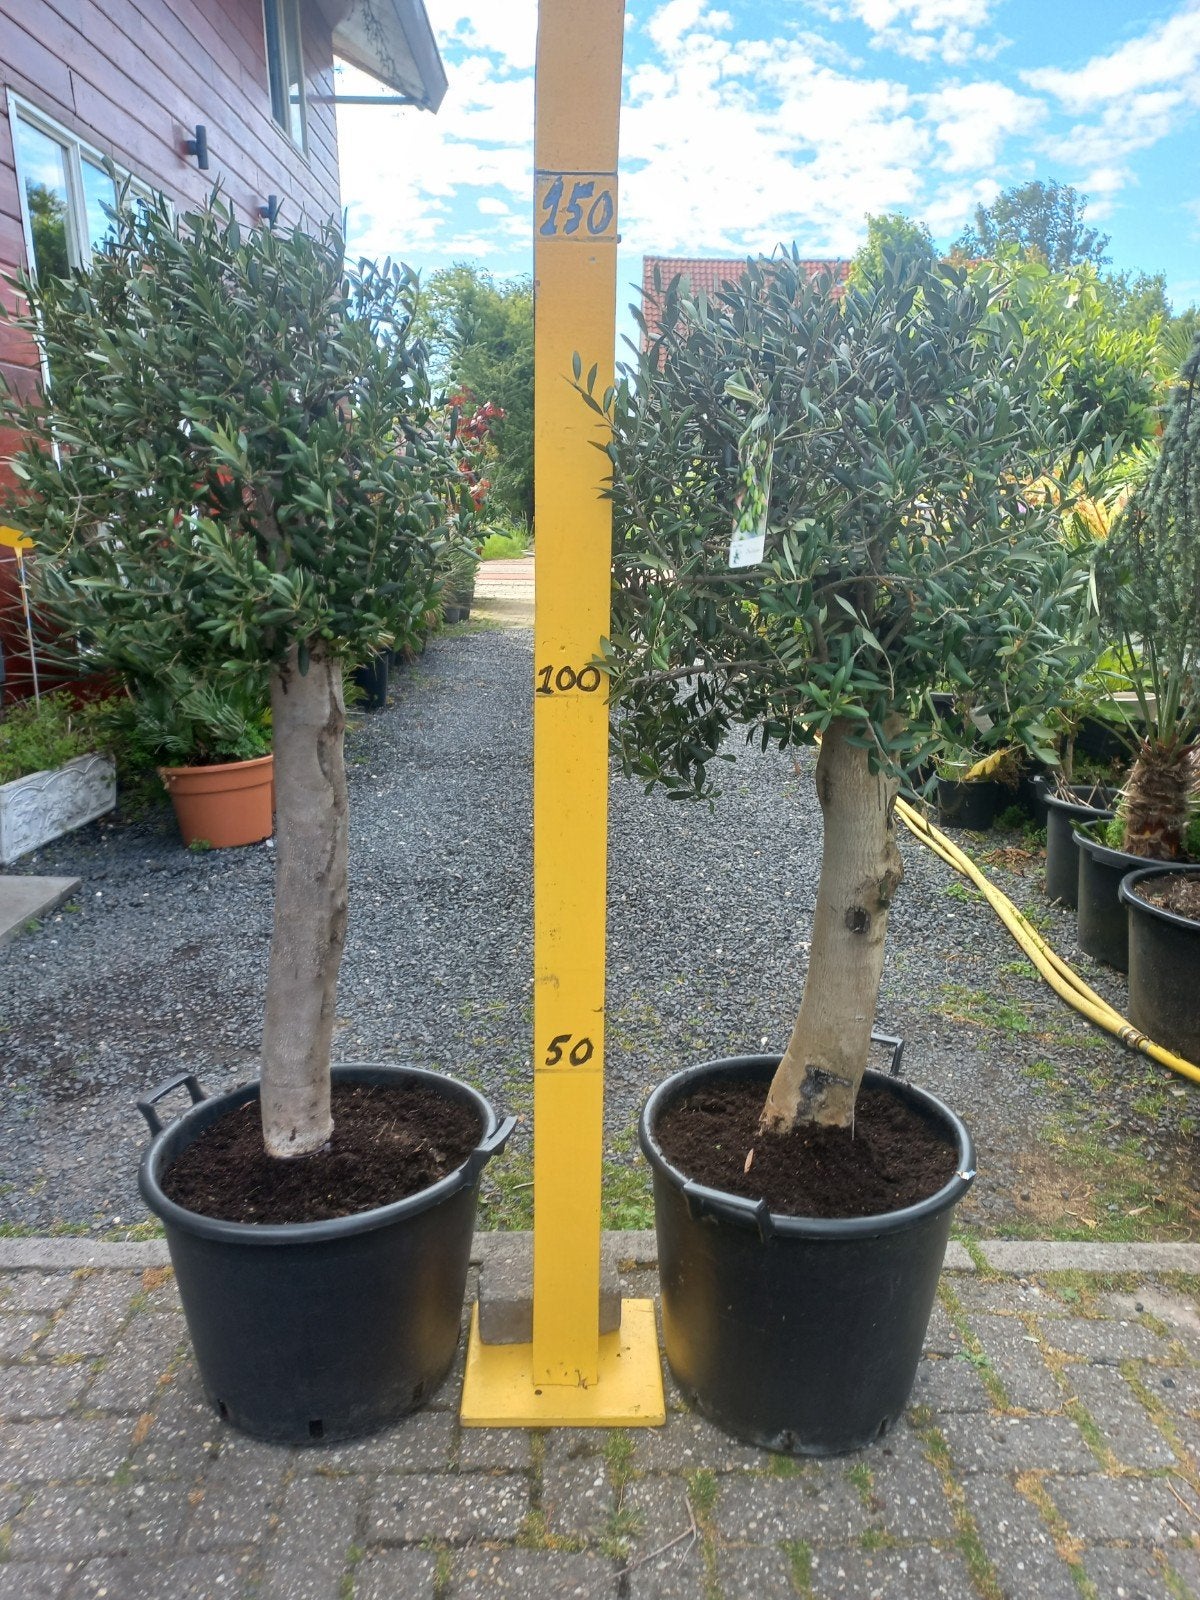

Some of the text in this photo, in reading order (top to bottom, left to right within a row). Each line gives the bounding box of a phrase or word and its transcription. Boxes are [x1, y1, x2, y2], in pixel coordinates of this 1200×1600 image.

[540, 176, 613, 235] 150
[536, 665, 600, 694] 100
[545, 1034, 594, 1067] 50
